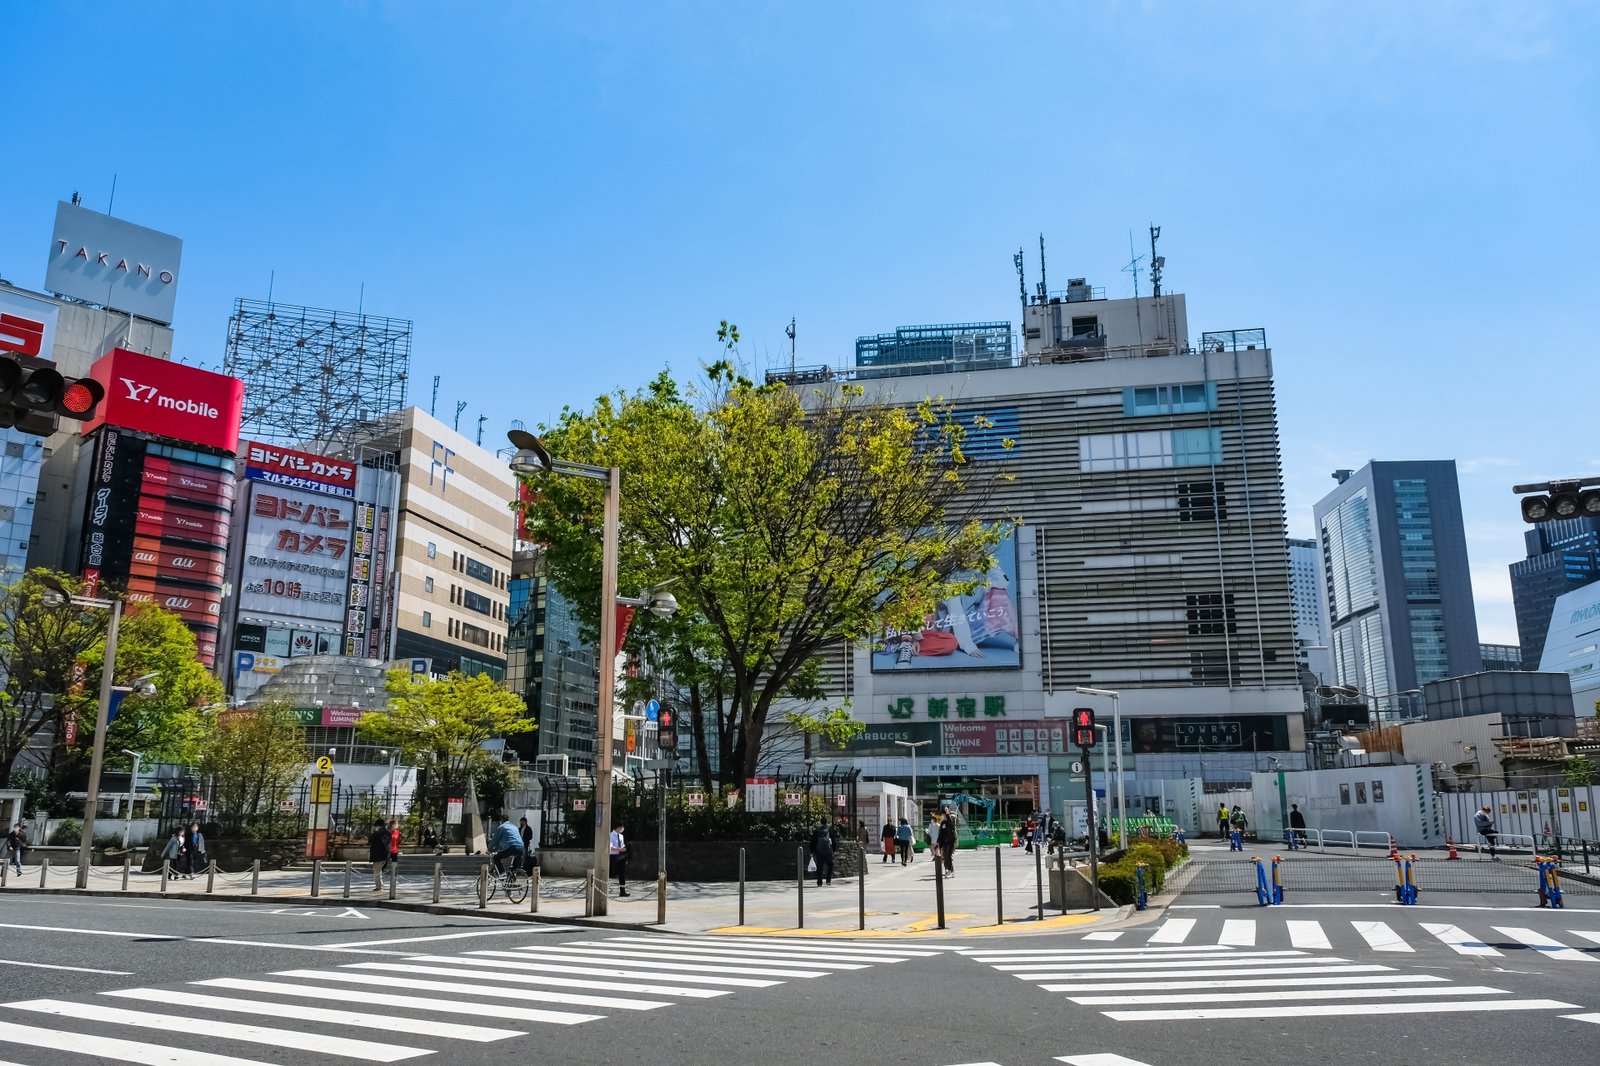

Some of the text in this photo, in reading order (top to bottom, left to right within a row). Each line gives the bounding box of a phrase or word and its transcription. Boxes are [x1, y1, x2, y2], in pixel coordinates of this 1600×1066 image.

[58, 239, 173, 284] TAKANO
[250, 447, 353, 481] ヨドバシカメラ
[255, 493, 350, 530] ヨドバシ
[276, 529, 348, 560] カメラ
[135, 552, 157, 562] au
[172, 557, 196, 568] au
[129, 593, 151, 602] au
[165, 597, 192, 609] au
[235, 652, 255, 679] P
[888, 695, 1006, 719] JR 新宿駅
[944, 724, 987, 732] Welcome
[1178, 724, 1238, 734] LOWRYS
[852, 731, 909, 741] ARBUCKS
[1184, 735, 1233, 744] FARM
[944, 738, 981, 747] LUMINE
[945, 747, 961, 755] EST
[320, 758, 329, 770] 2
